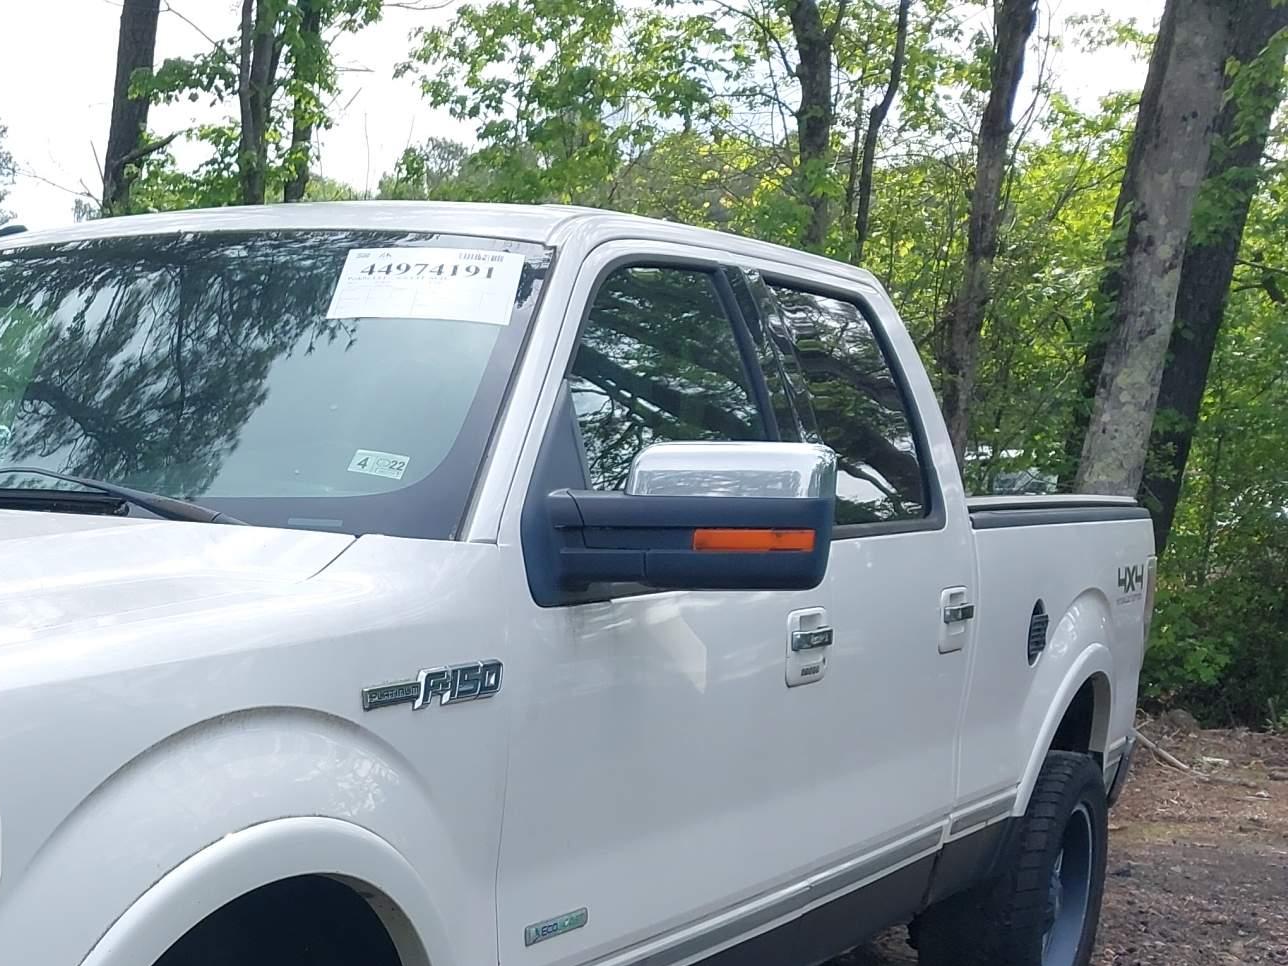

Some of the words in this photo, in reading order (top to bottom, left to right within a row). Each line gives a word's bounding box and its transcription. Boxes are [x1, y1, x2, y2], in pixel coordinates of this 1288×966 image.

[360, 262, 495, 280] 44974191
[357, 456, 370, 469] 4
[388, 459, 406, 471] 22
